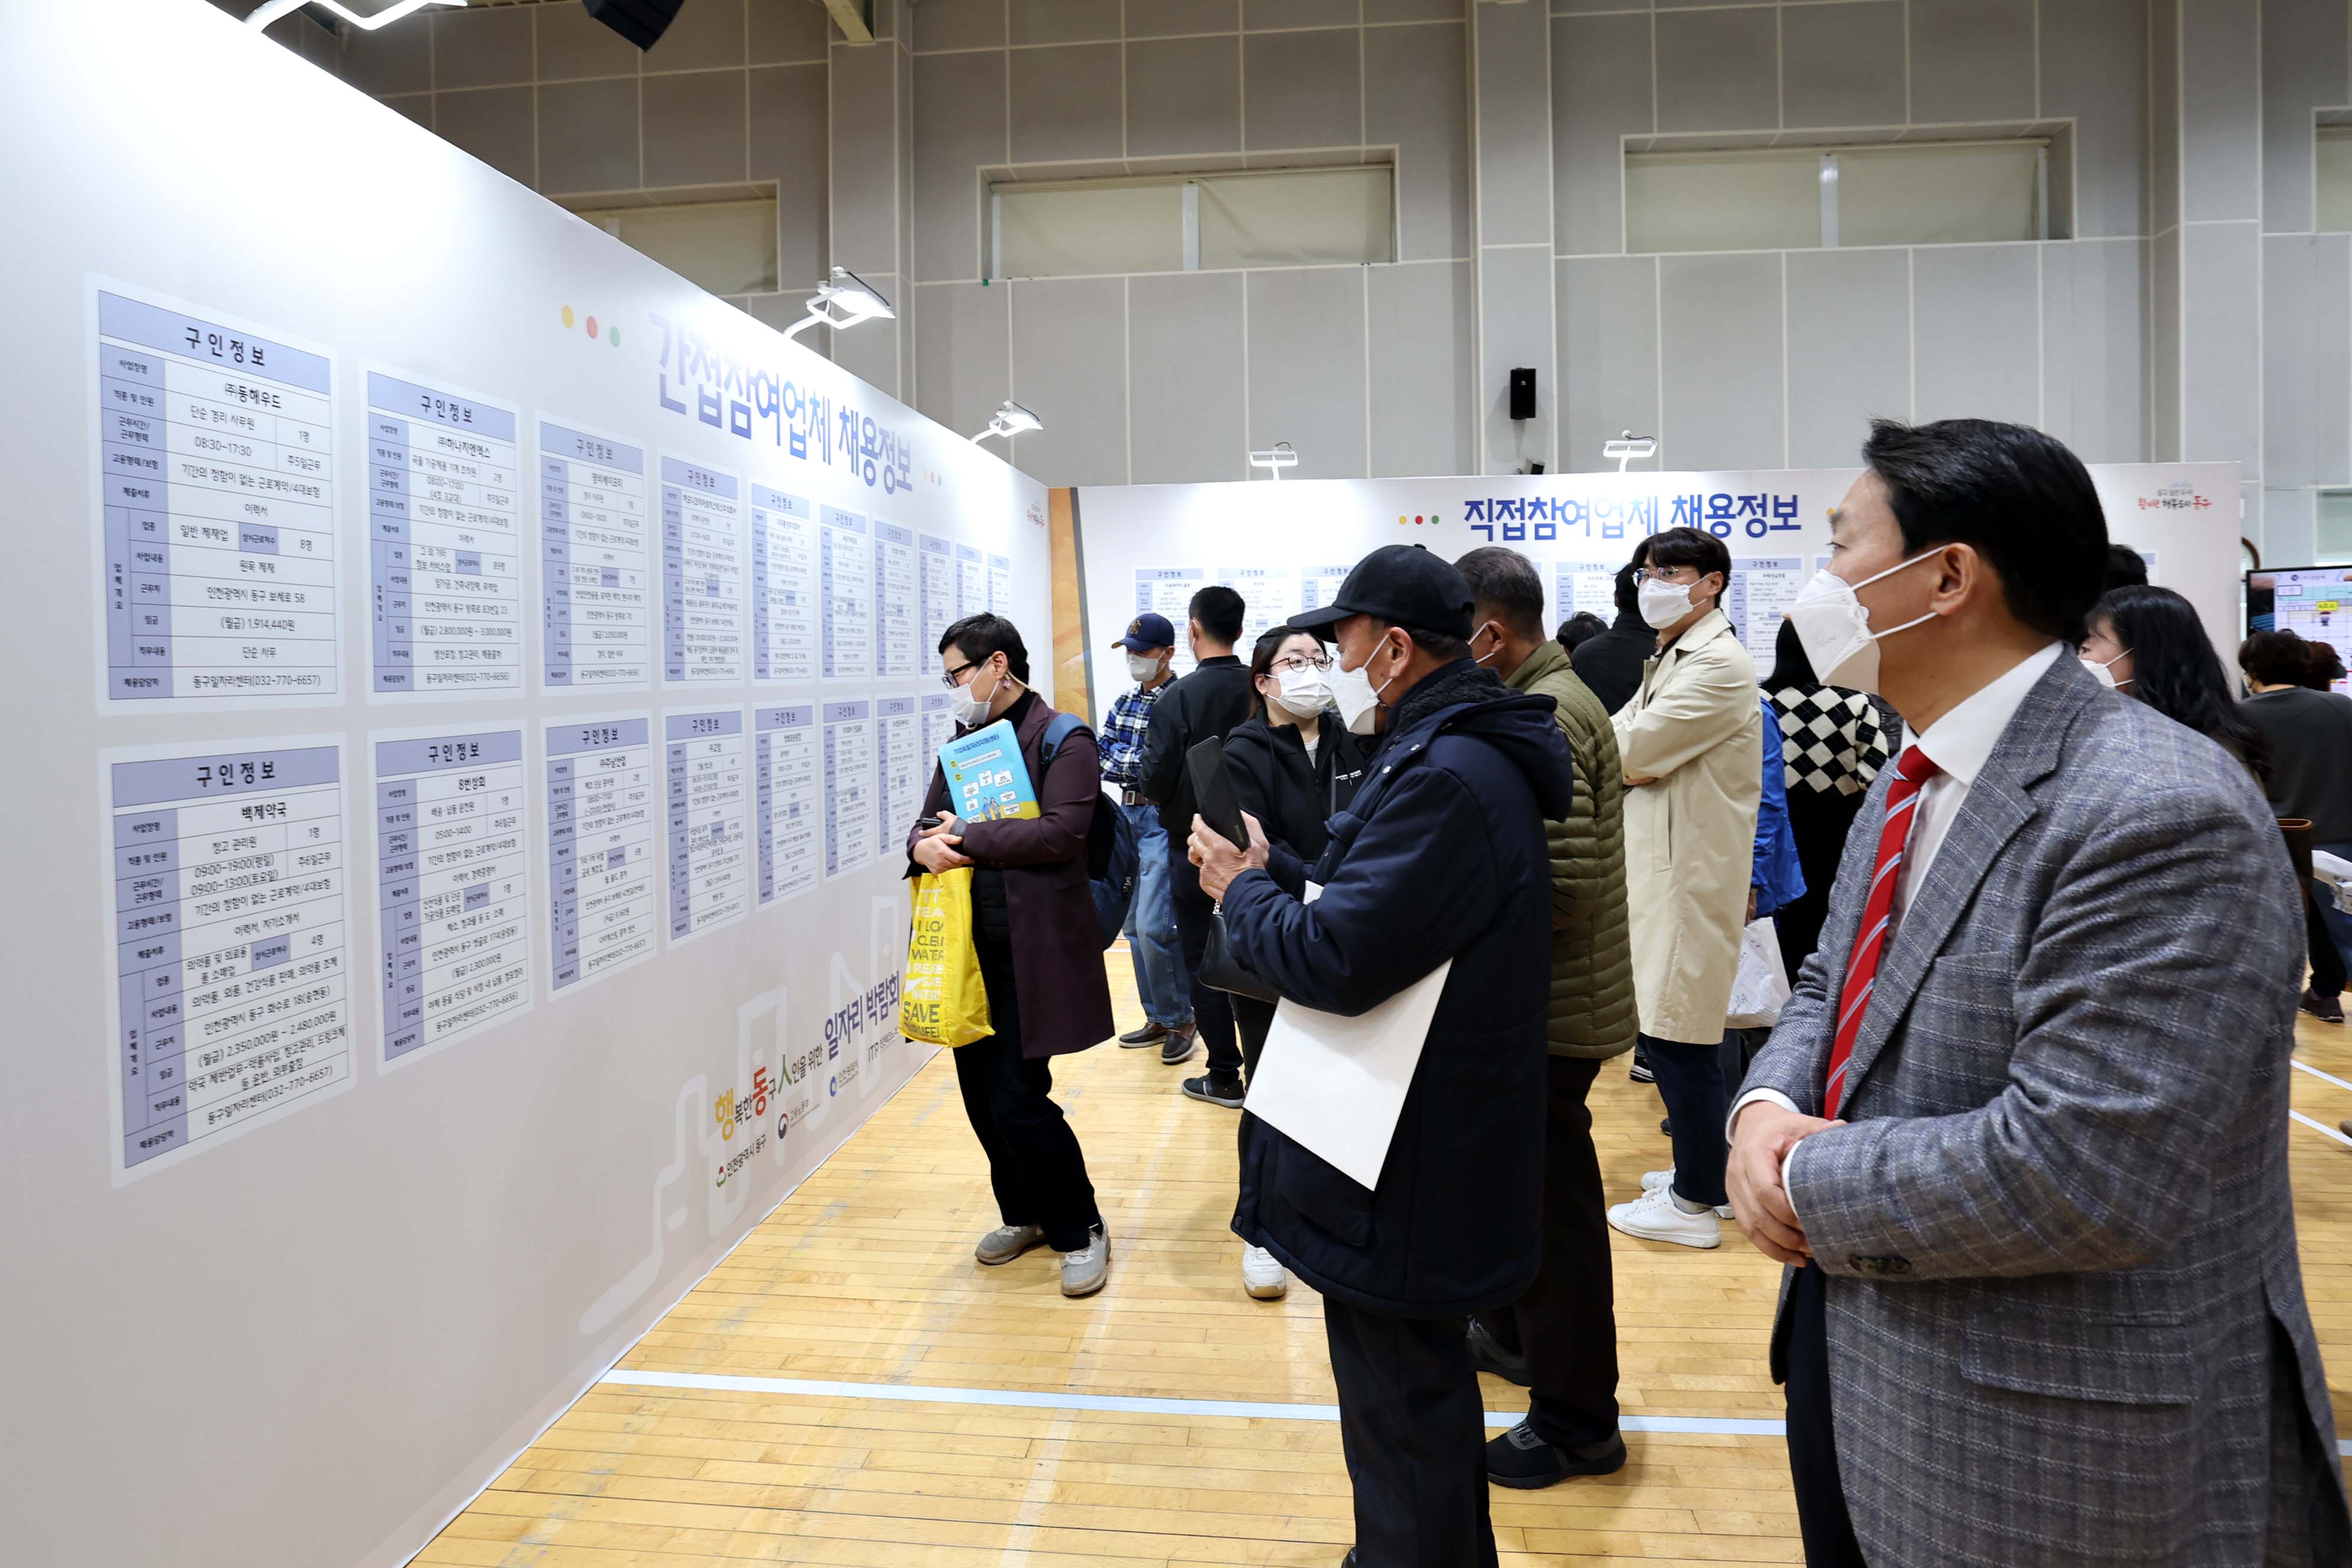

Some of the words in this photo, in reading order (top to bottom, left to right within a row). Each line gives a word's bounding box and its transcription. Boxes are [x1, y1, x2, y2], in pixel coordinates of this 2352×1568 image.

[119, 360, 147, 374] 사업장명
[114, 390, 128, 401] 직종
[130, 393, 138, 403] 및
[139, 395, 154, 407] 인원
[649, 312, 832, 465] 간접참여업체
[838, 405, 913, 495] 채용정보
[191, 405, 207, 420] 단순
[210, 409, 227, 423] 경리
[231, 415, 254, 430] 사무원
[120, 429, 149, 442] 근무형태
[298, 430, 309, 443] 1명
[113, 453, 158, 470] 고용형태/보험
[288, 455, 321, 471] 주5일근무
[182, 463, 207, 478] 기간의
[211, 469, 236, 483] 정함이
[239, 473, 255, 488] 없는
[259, 476, 319, 498] 근로계약/4대보험
[123, 487, 149, 499] 제출서류
[245, 504, 267, 516] 이력서
[1465, 494, 1658, 541] 직접참여업체
[1671, 494, 1802, 538] 채용정보
[142, 521, 155, 531] 업종
[181, 524, 198, 538] 일반
[243, 534, 275, 544] 상시근로자수
[300, 539, 312, 551] 8명
[136, 552, 163, 563] 사업내용
[239, 559, 255, 572] 원목
[259, 561, 275, 574] 제재
[140, 583, 161, 593] 근무지
[207, 587, 247, 600] 인천광역시
[251, 589, 266, 602] 동구
[269, 592, 292, 602] 보세로
[294, 592, 305, 603] 58
[145, 615, 158, 625] 임금
[221, 616, 245, 629] (월급)
[139, 646, 165, 656] 직무내용
[243, 646, 258, 659] 단순
[261, 647, 276, 658] 사무
[124, 678, 159, 688] 채용담당자
[459, 776, 485, 791] 8번상회
[241, 802, 286, 821] 백제약국
[133, 822, 160, 833] 사업장명
[309, 827, 319, 838] 1명
[212, 841, 229, 854] 창고
[232, 836, 257, 851] 관리원
[128, 855, 141, 865] 직종
[143, 854, 151, 863] 및
[152, 851, 167, 863] 인원
[298, 851, 331, 866] 주6일근무
[195, 901, 220, 916] 기간의
[223, 896, 248, 912] 정함이
[251, 893, 267, 906] 없는
[270, 878, 330, 901] 근로계약/4대보험
[128, 913, 172, 930] 고용형태/보험
[263, 913, 299, 929] 자기소개서
[311, 934, 324, 946] 4명
[187, 955, 211, 970] 의약품
[214, 953, 221, 963] 및
[212, 965, 235, 980] 소매업
[245, 974, 276, 993] 건강식품
[299, 961, 321, 976] 의약품
[324, 956, 337, 969] 조제
[204, 1013, 246, 1035] 인천광역시
[249, 1006, 264, 1021] 동구
[267, 998, 290, 1014] 화수로
[903, 1001, 940, 1023] SAVE
[808, 1044, 823, 1070] 위한
[825, 995, 863, 1061] 일자리
[866, 970, 900, 1025] 박람회
[188, 1077, 206, 1092] 약국
[318, 1027, 345, 1045] 드링크제
[199, 1048, 224, 1067] (월급)
[868, 1042, 879, 1063] ITP
[241, 1077, 249, 1090] 등
[727, 1143, 755, 1178] 인천광역시
[755, 1133, 767, 1153] 동구
